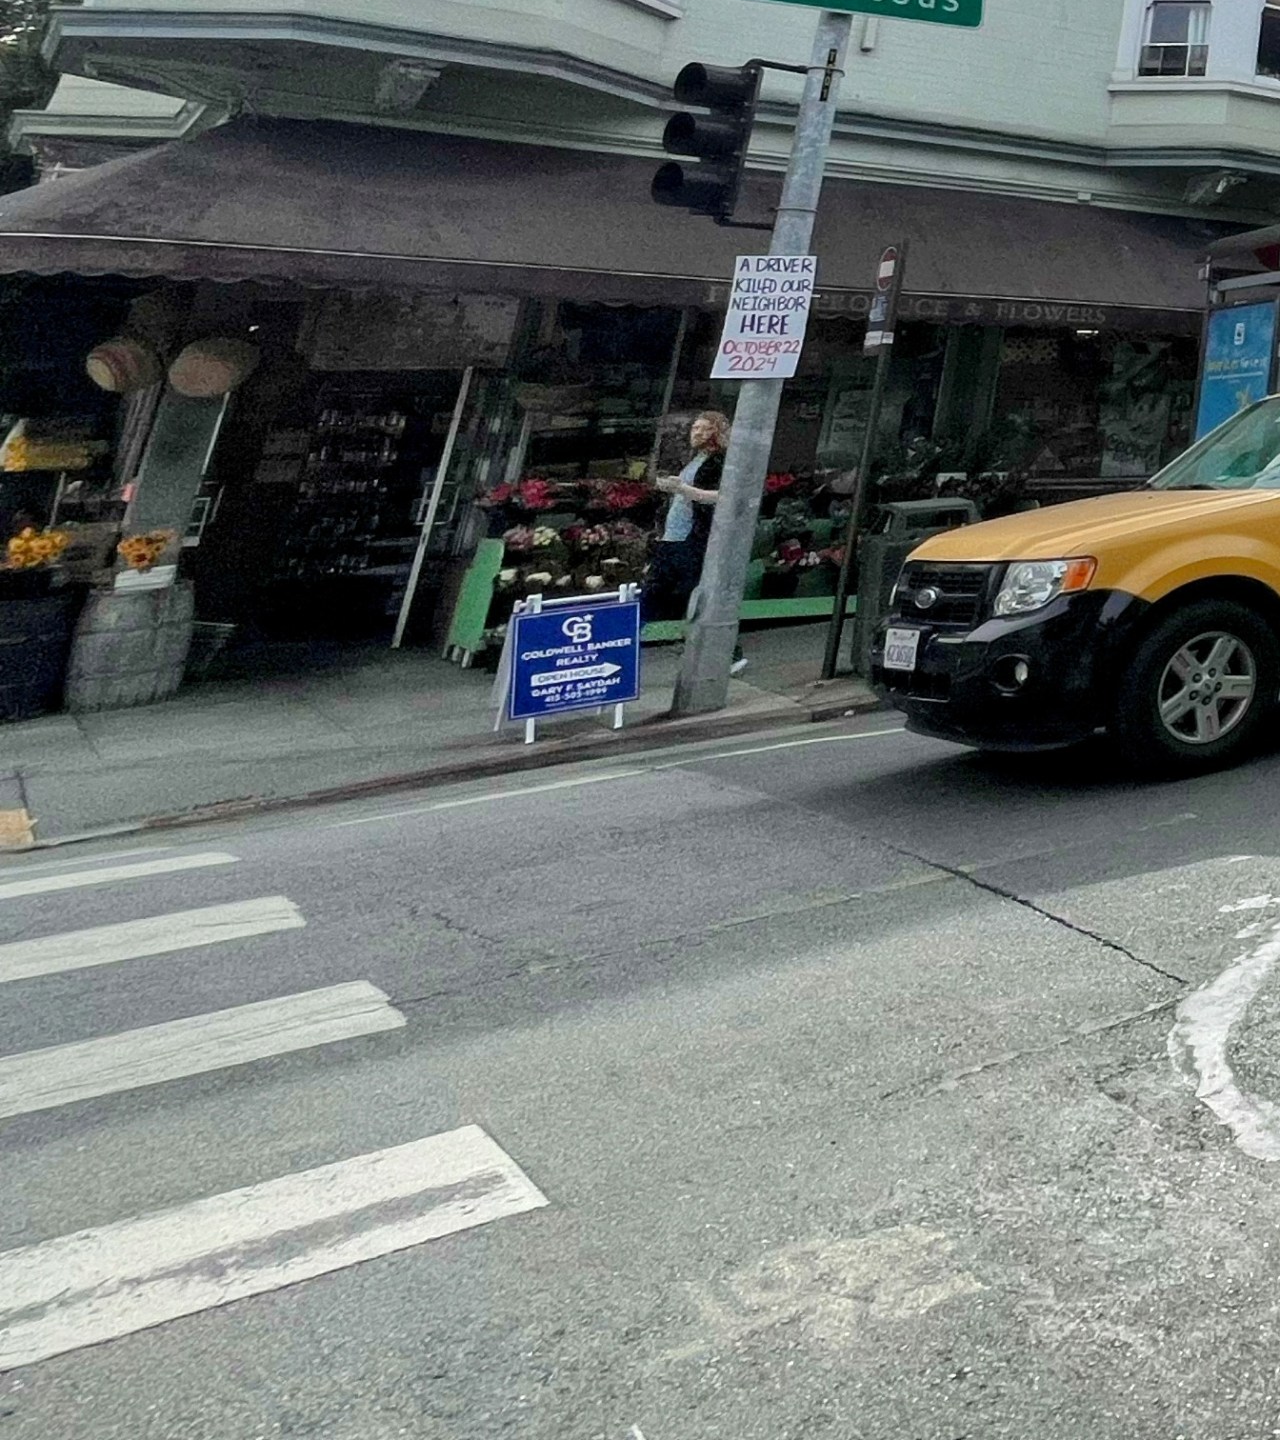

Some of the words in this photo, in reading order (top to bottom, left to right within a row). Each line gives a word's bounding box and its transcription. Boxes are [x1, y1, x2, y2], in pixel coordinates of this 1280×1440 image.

[740, 258, 750, 273] A
[756, 258, 813, 273] DRIVER
[734, 278, 777, 294] KILLED
[780, 278, 812, 293] OUR
[731, 296, 806, 312] NEIGHBOR
[816, 292, 951, 317] PROUCE
[995, 301, 1108, 324] FLOWERS
[740, 314, 790, 335] HERE
[723, 340, 781, 355] OCTOBER
[782, 339, 800, 355] 22
[728, 356, 777, 371] 2024
[521, 644, 584, 661] COLDWELL
[587, 637, 632, 652] BANKER
[555, 653, 599, 667] REALTY
[537, 671, 567, 684] OPEN
[570, 666, 606, 680] HOUSE
[531, 684, 564, 697] GARY
